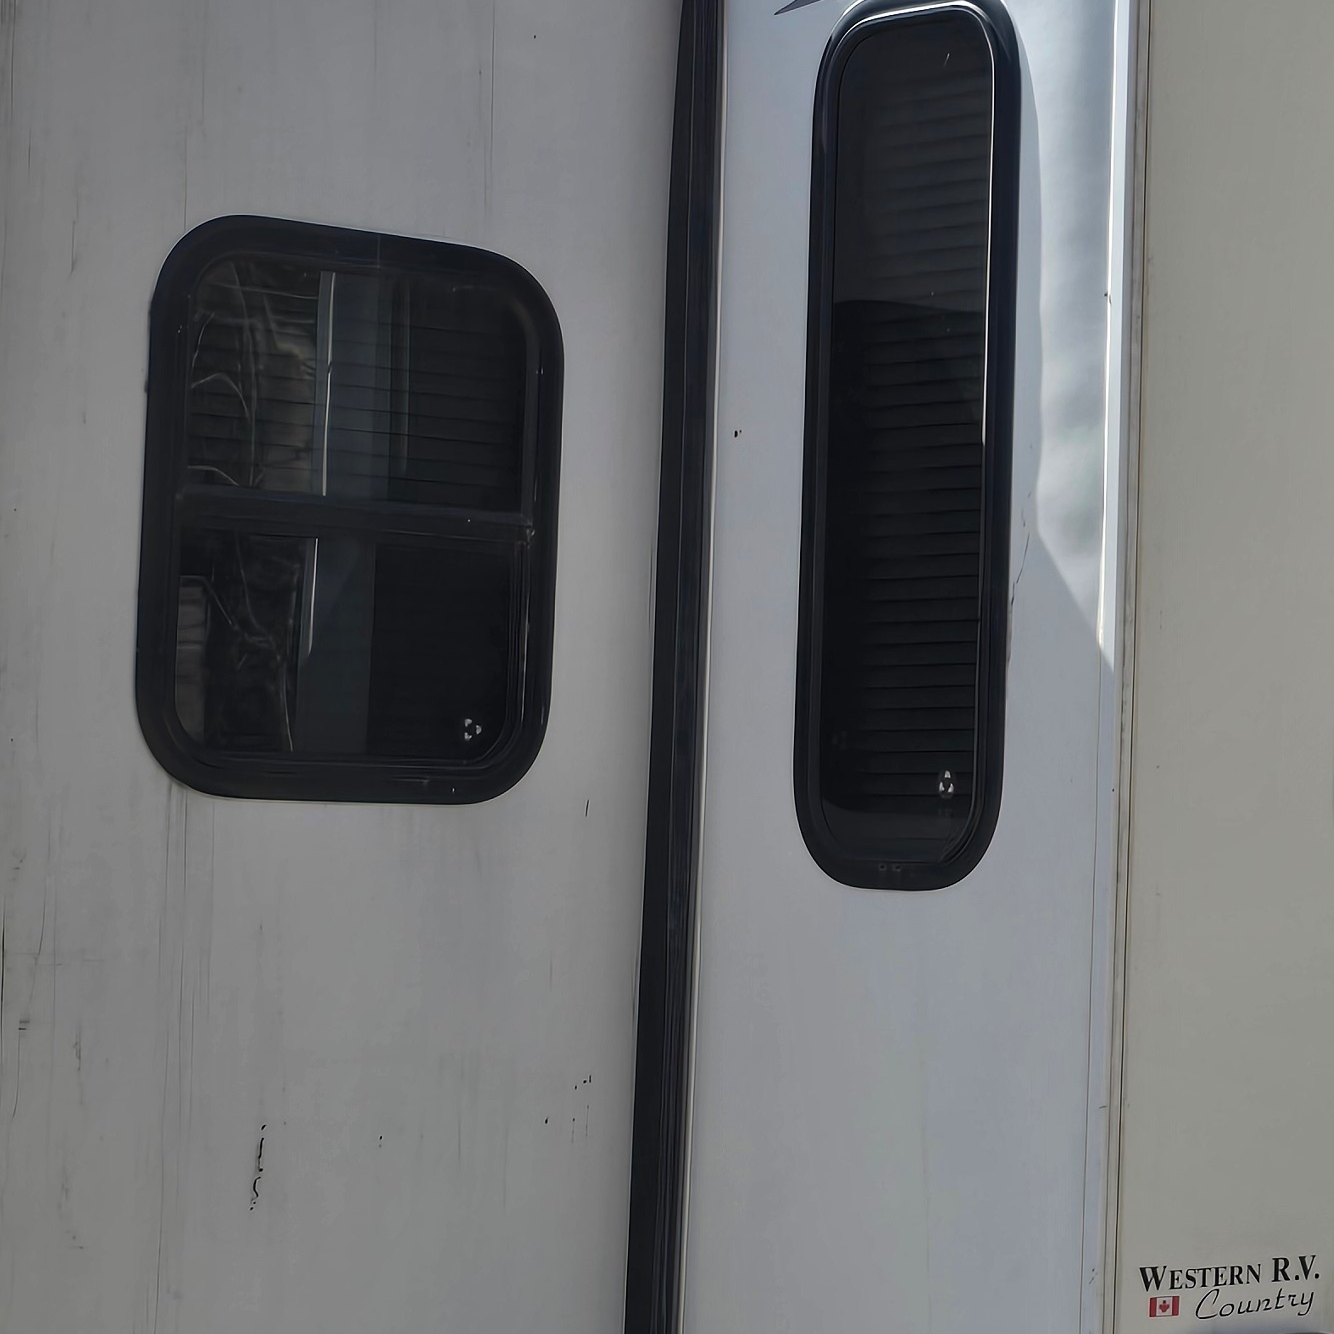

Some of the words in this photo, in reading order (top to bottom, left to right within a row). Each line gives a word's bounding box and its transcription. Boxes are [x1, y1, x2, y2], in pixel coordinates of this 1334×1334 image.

[1139, 1263, 1261, 1292] WESTERN
[1271, 1254, 1320, 1282] R.V.
[1195, 1288, 1314, 1320] Country
